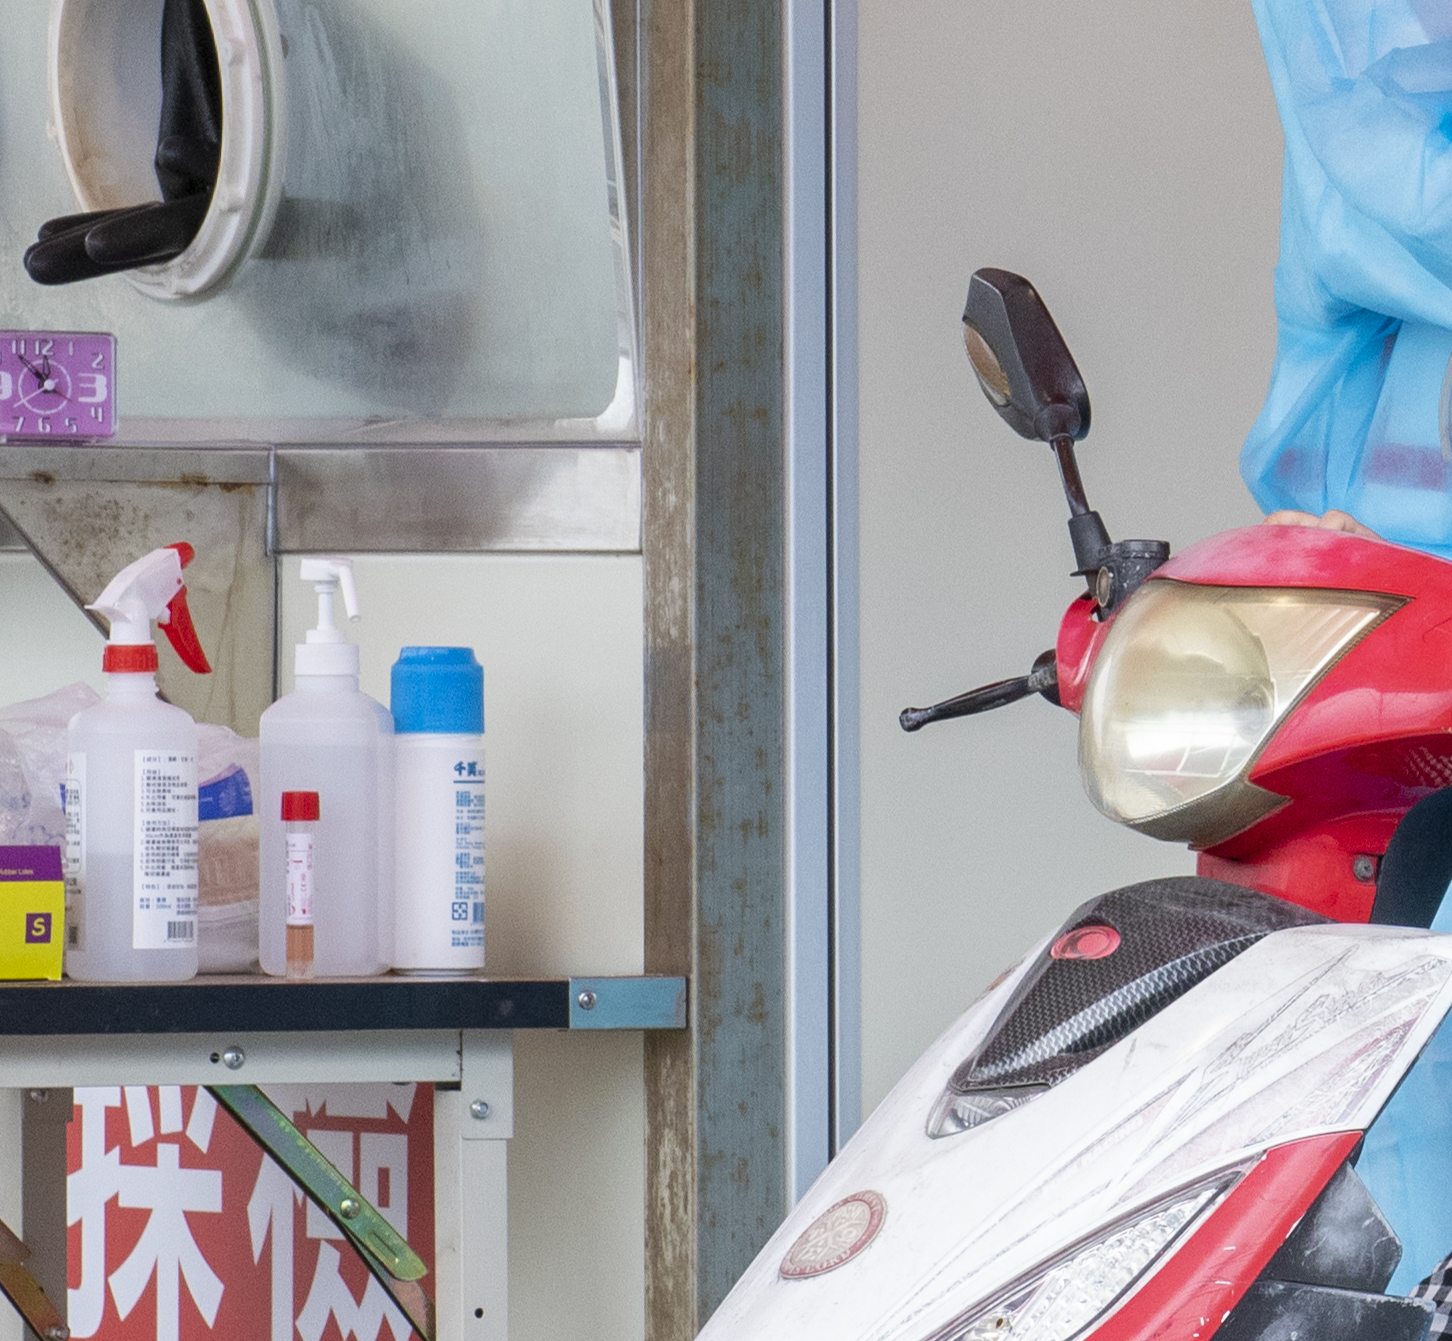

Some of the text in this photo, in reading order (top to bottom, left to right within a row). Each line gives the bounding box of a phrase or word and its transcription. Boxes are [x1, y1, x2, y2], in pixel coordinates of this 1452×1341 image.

[12, 340, 26, 355] 11
[35, 340, 55, 355] 12
[91, 352, 105, 369] 2
[78, 373, 108, 403] 3
[13, 416, 25, 433] 7
[38, 417, 51, 433] 6
[64, 417, 78, 433] 5
[32, 918, 45, 937] S
